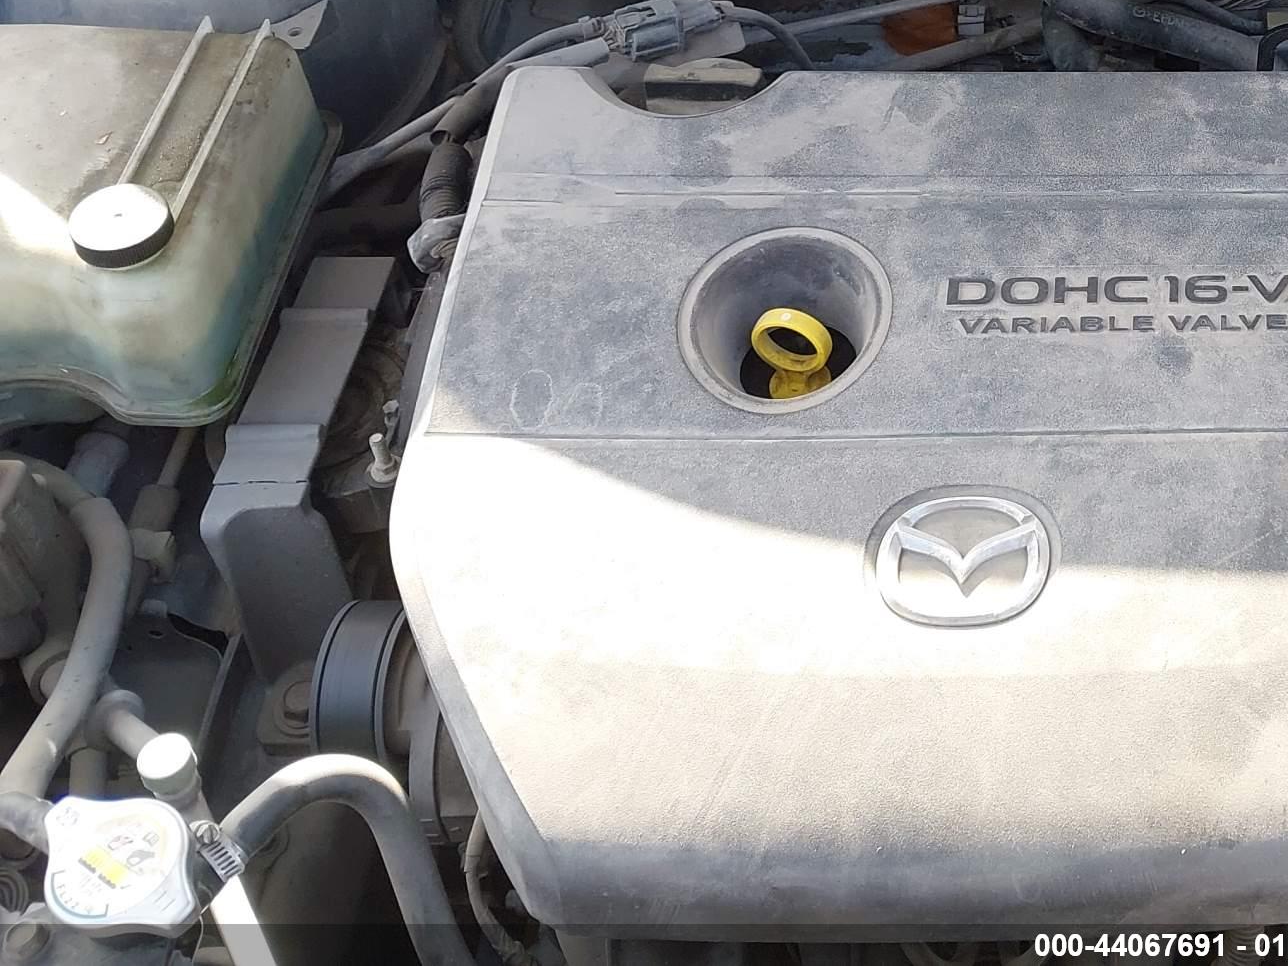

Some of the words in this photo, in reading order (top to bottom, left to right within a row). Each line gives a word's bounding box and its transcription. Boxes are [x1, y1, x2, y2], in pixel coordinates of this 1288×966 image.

[945, 274, 1149, 306] DOHC
[958, 315, 1155, 335] VARIABLE
[1167, 313, 1288, 333] VALVE
